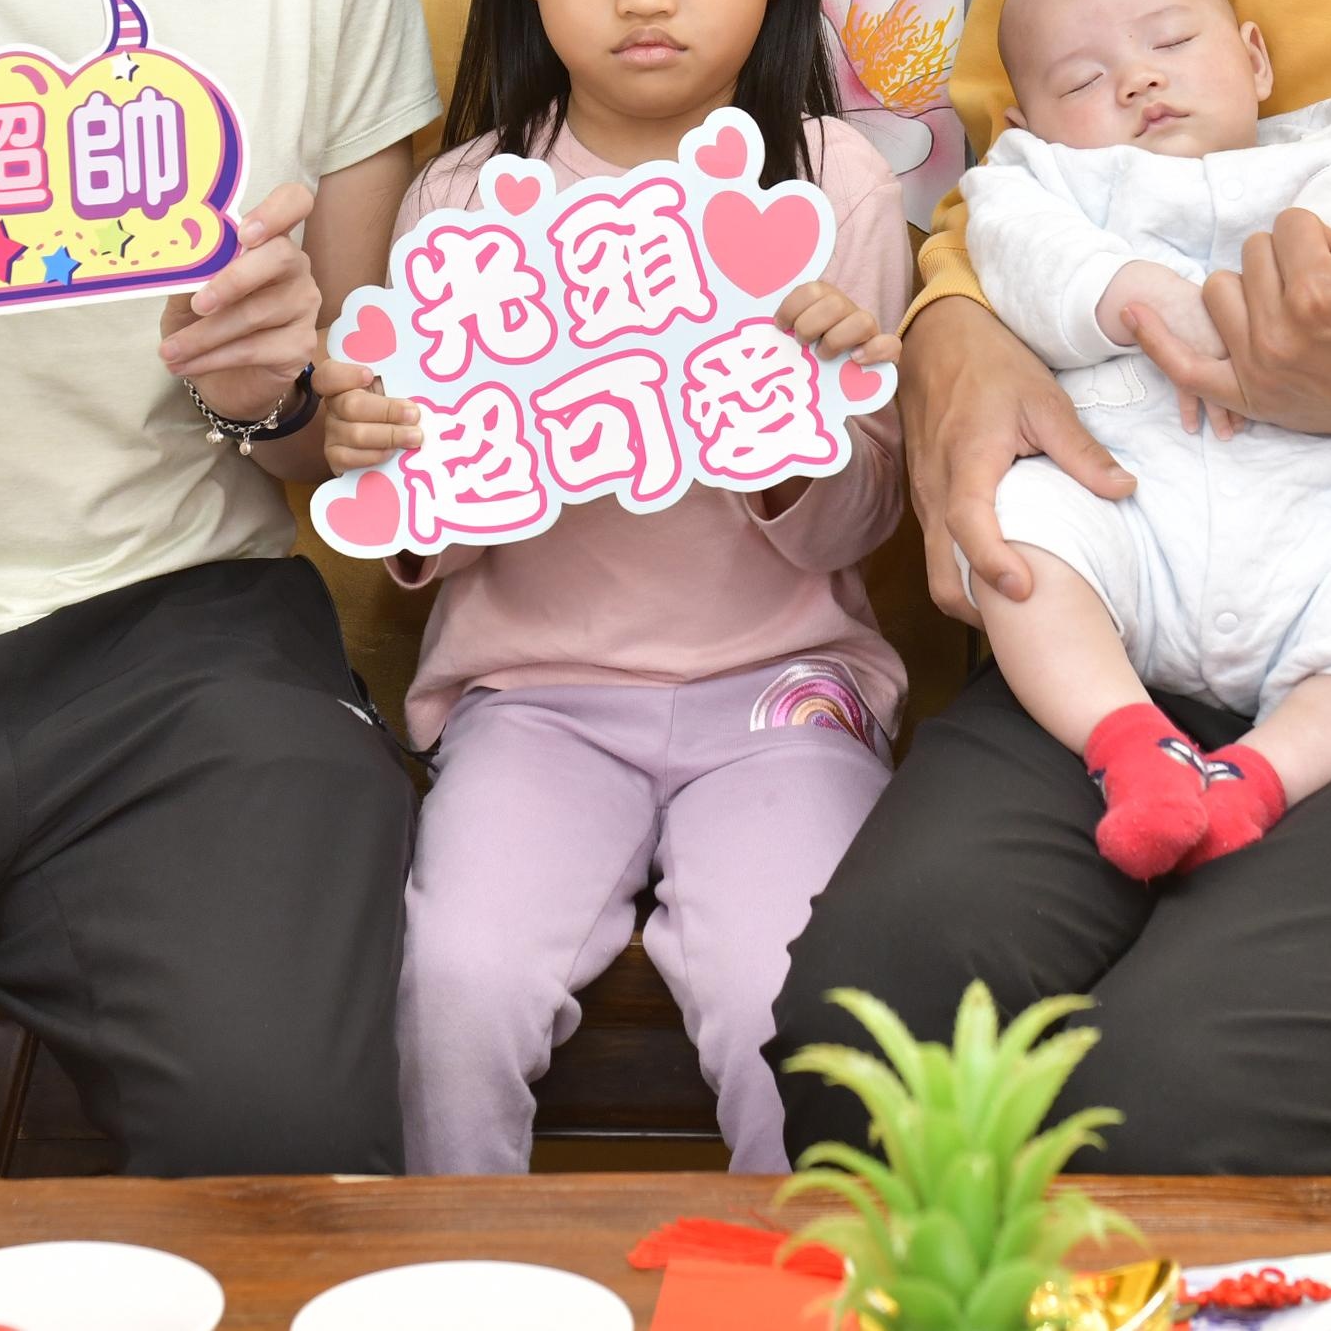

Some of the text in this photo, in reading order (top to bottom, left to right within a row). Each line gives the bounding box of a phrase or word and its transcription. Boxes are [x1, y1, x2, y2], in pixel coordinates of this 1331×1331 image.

[405, 177, 718, 383] 光頭
[399, 316, 838, 544] 超可愛
